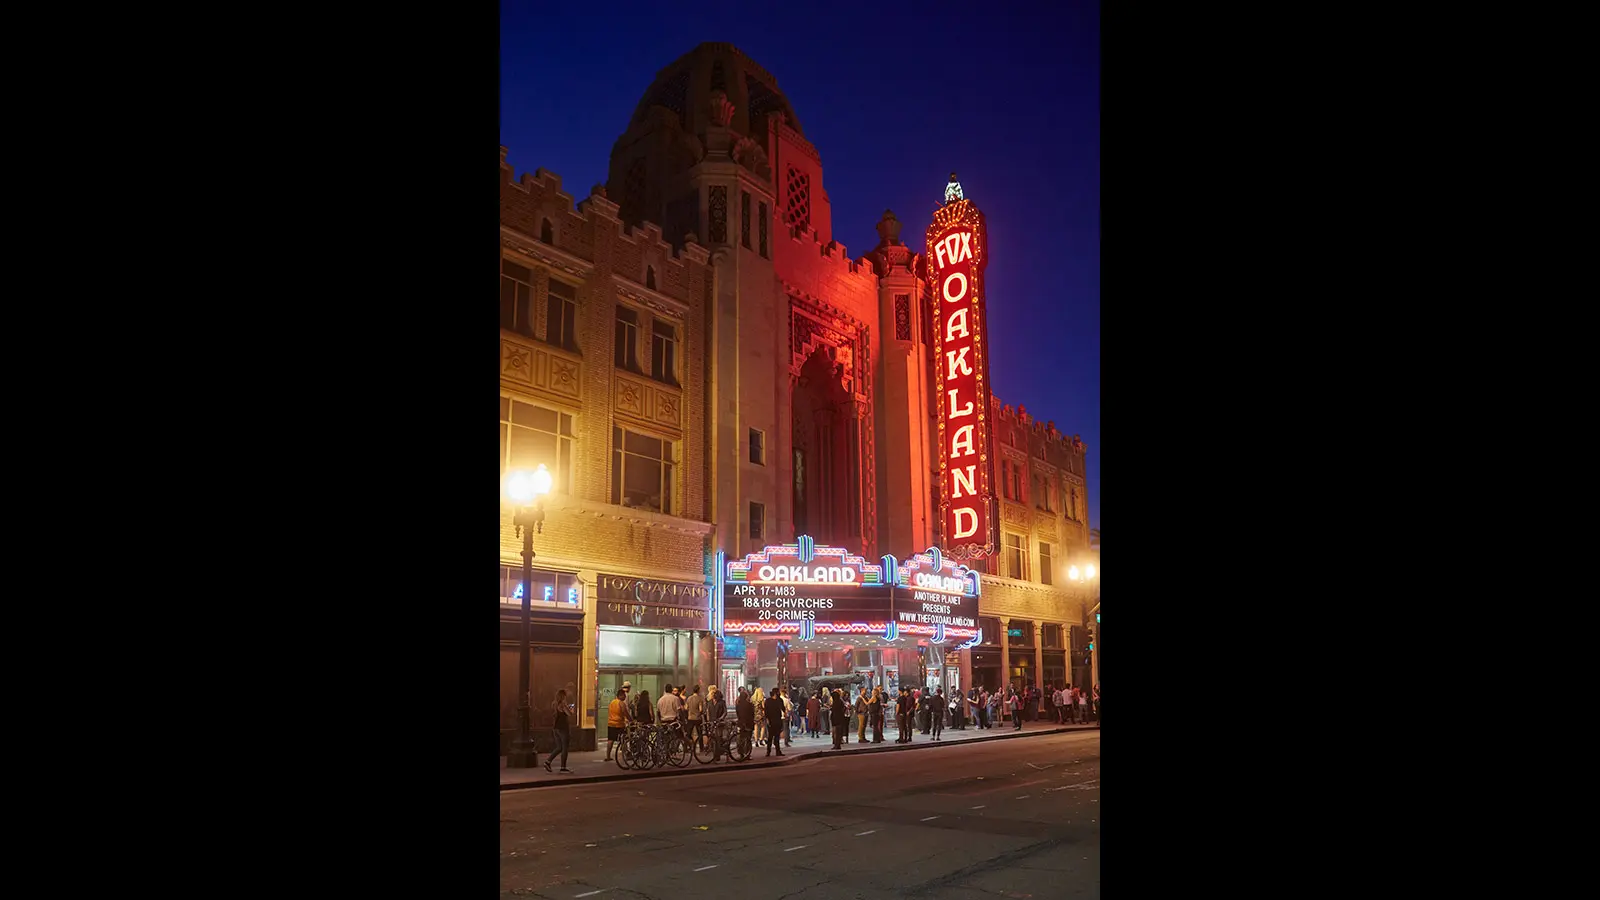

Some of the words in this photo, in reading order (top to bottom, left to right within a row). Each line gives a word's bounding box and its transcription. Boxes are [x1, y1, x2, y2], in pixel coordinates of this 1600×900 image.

[934, 232, 973, 269] FOX
[943, 272, 979, 540] OAKLAND
[758, 565, 855, 582] OAKLAND
[603, 577, 632, 591] FOX
[640, 581, 709, 598] OAKLAND
[914, 572, 964, 592] OAKLAND
[733, 585, 756, 596] APR
[760, 586, 796, 596] 17-M83
[742, 598, 833, 608] 18&19-CHVRCHES
[914, 591, 940, 603] ANOTHER
[941, 594, 961, 605] PLANET
[608, 602, 646, 615] OFFIE
[758, 610, 816, 620] 20-GRIMES
[922, 603, 951, 614] PRESENTS
[899, 612, 975, 627] WWW.THEFOXOAKLAND.COM
